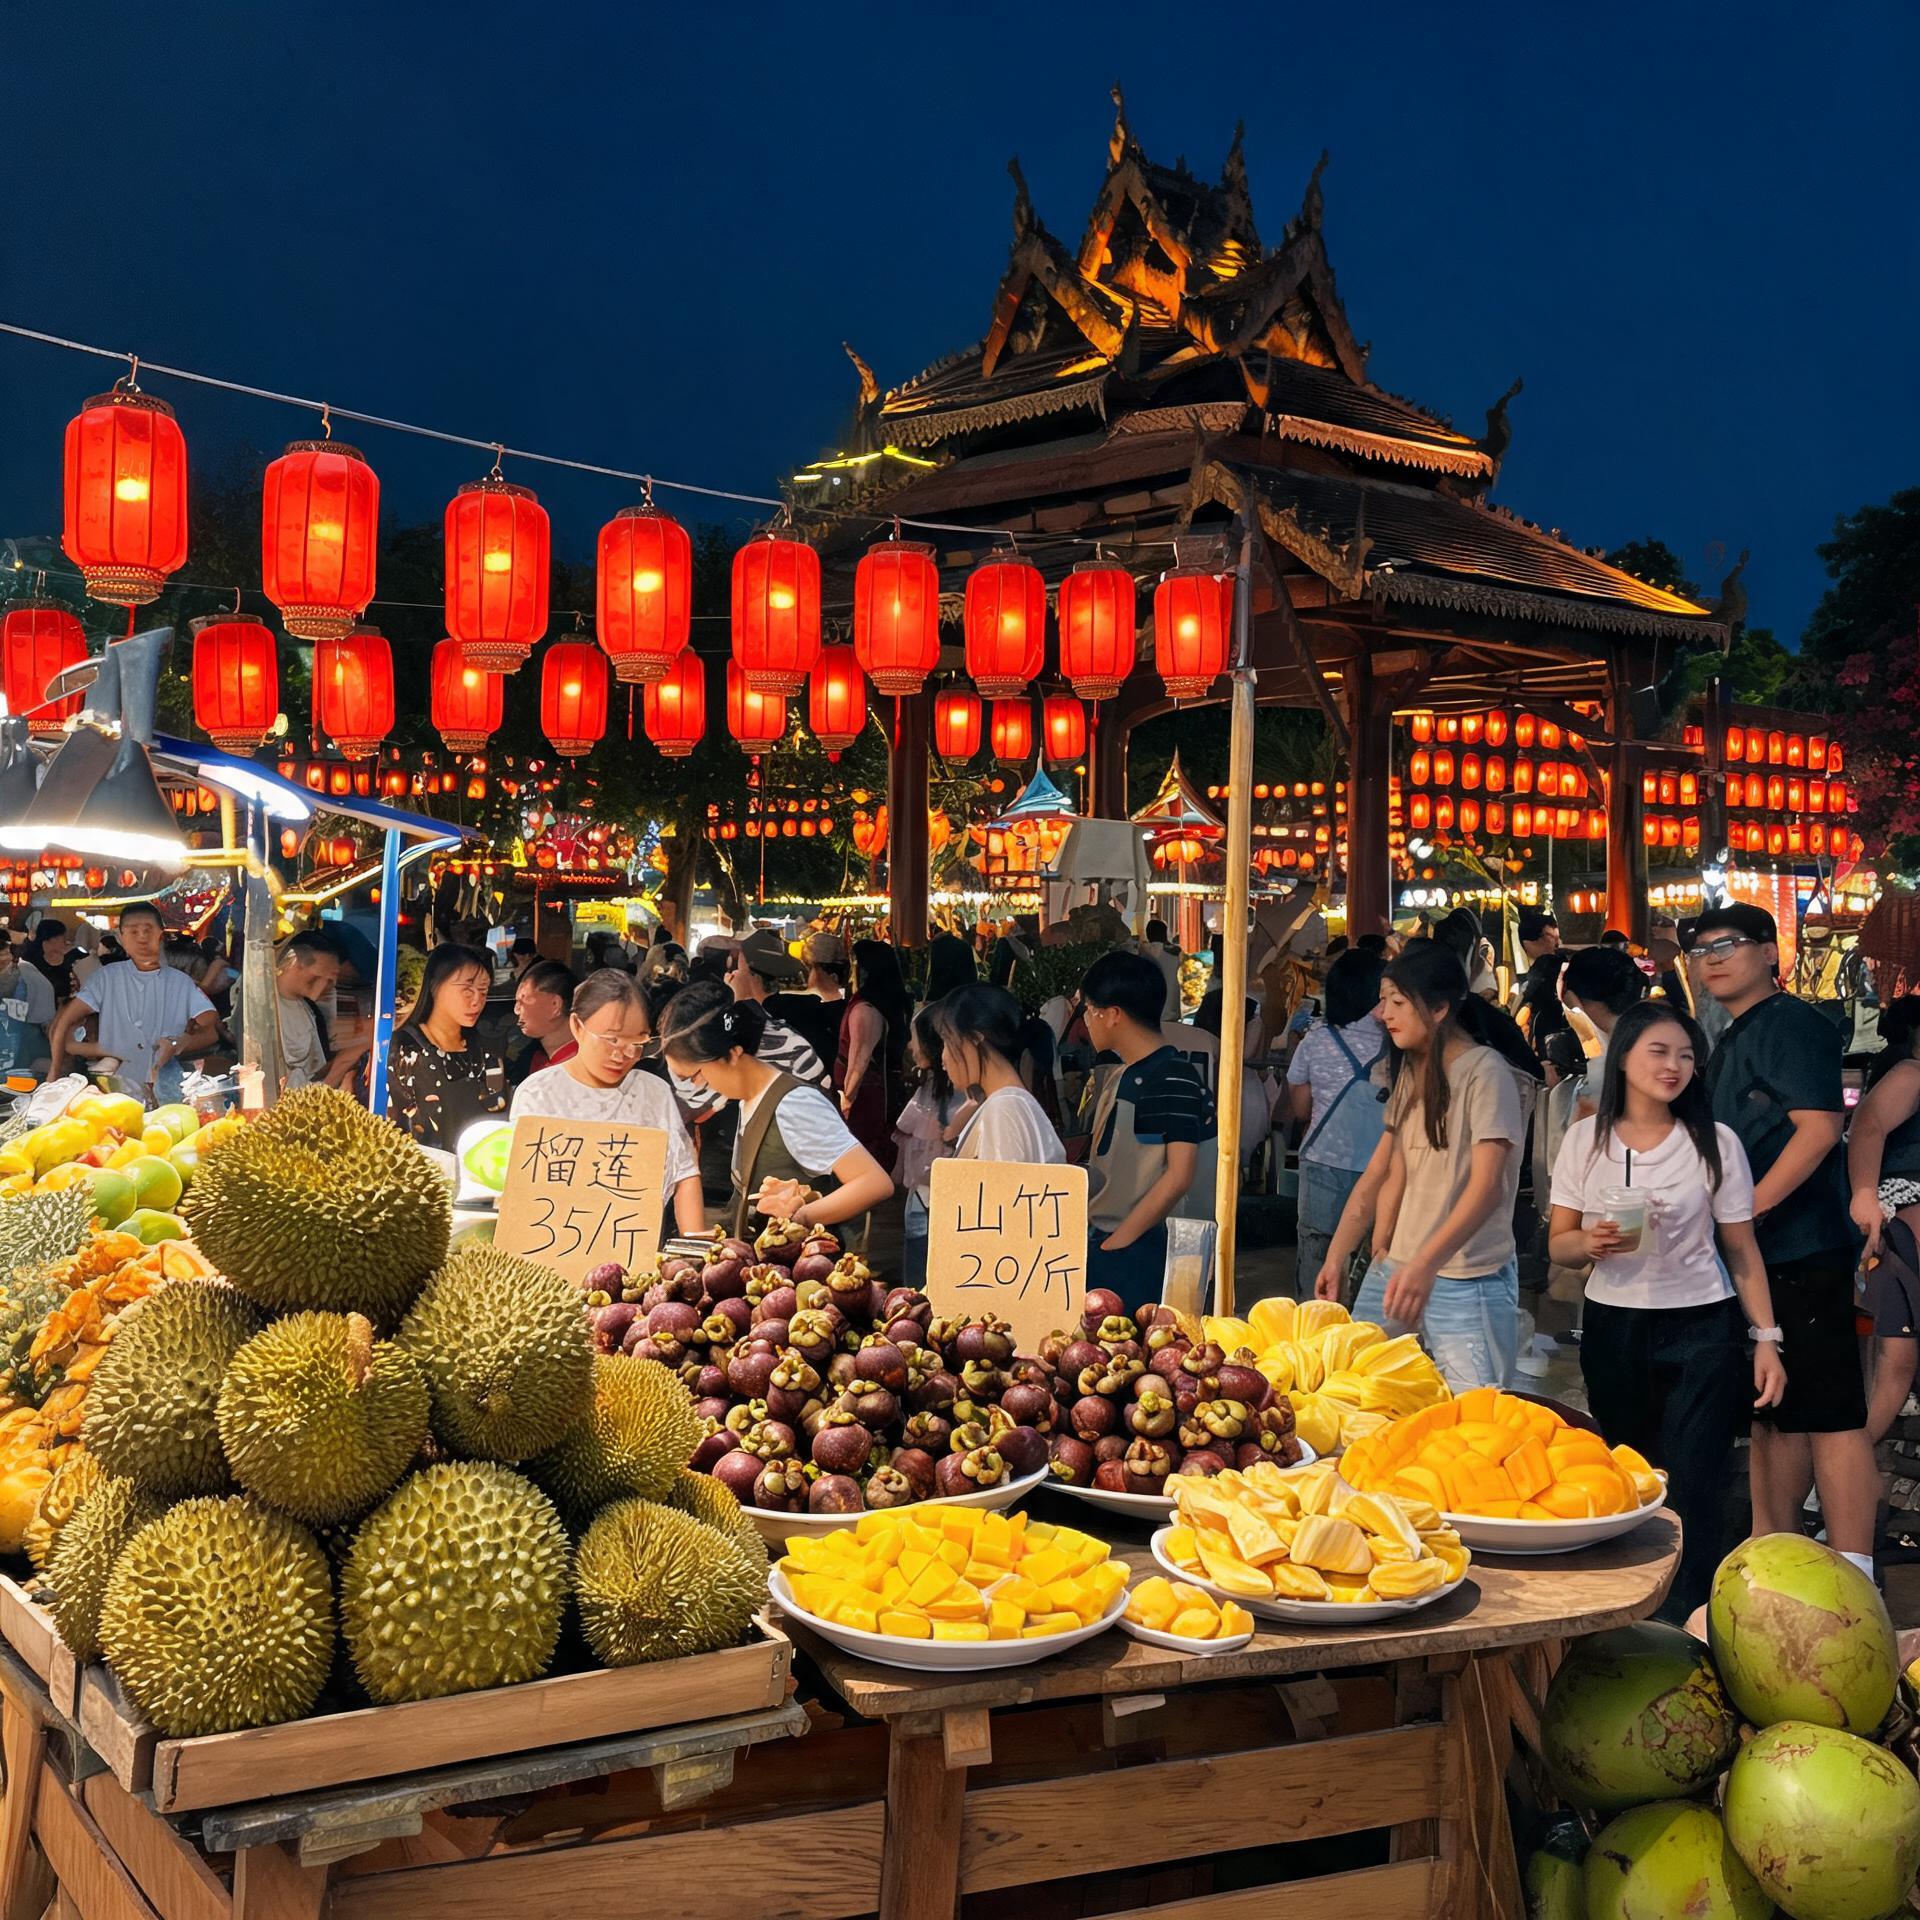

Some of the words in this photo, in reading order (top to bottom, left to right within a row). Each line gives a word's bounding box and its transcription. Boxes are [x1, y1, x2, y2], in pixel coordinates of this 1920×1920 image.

[521, 1127, 649, 1201] 榴莲
[520, 1197, 650, 1268] 35/斤
[956, 1181, 1070, 1239] 山竹
[955, 1245, 1081, 1311] 20/斤
